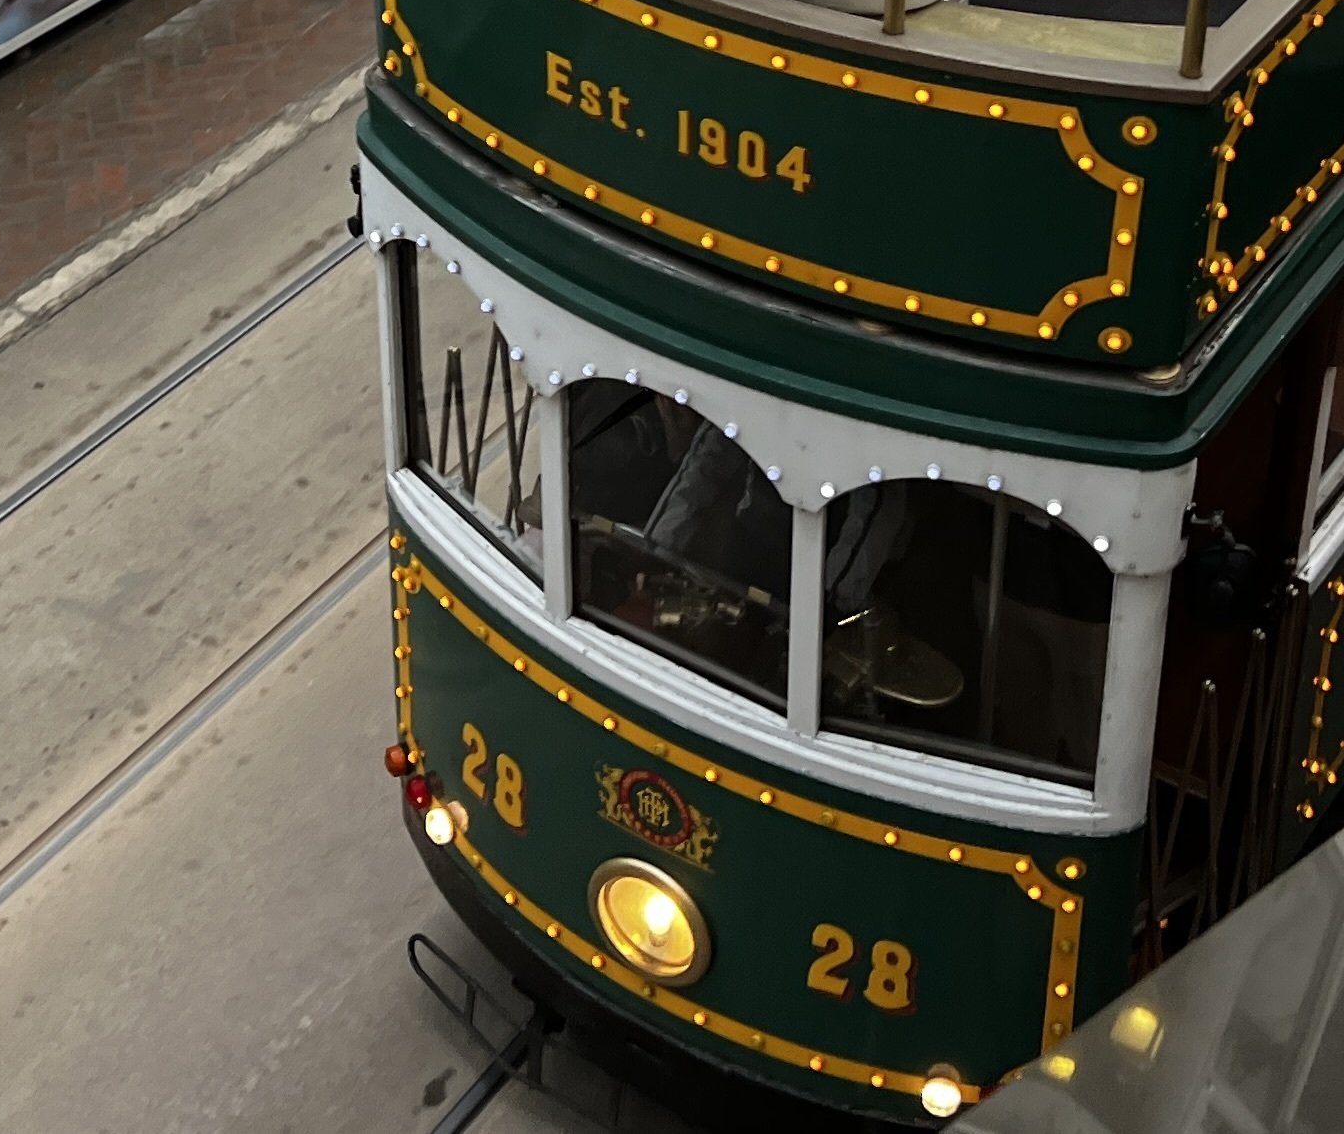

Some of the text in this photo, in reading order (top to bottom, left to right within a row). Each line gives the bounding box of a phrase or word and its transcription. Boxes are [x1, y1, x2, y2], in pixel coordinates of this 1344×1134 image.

[545, 50, 812, 194] Est. 1904
[460, 722, 526, 830] 28
[806, 922, 917, 1012] 28
